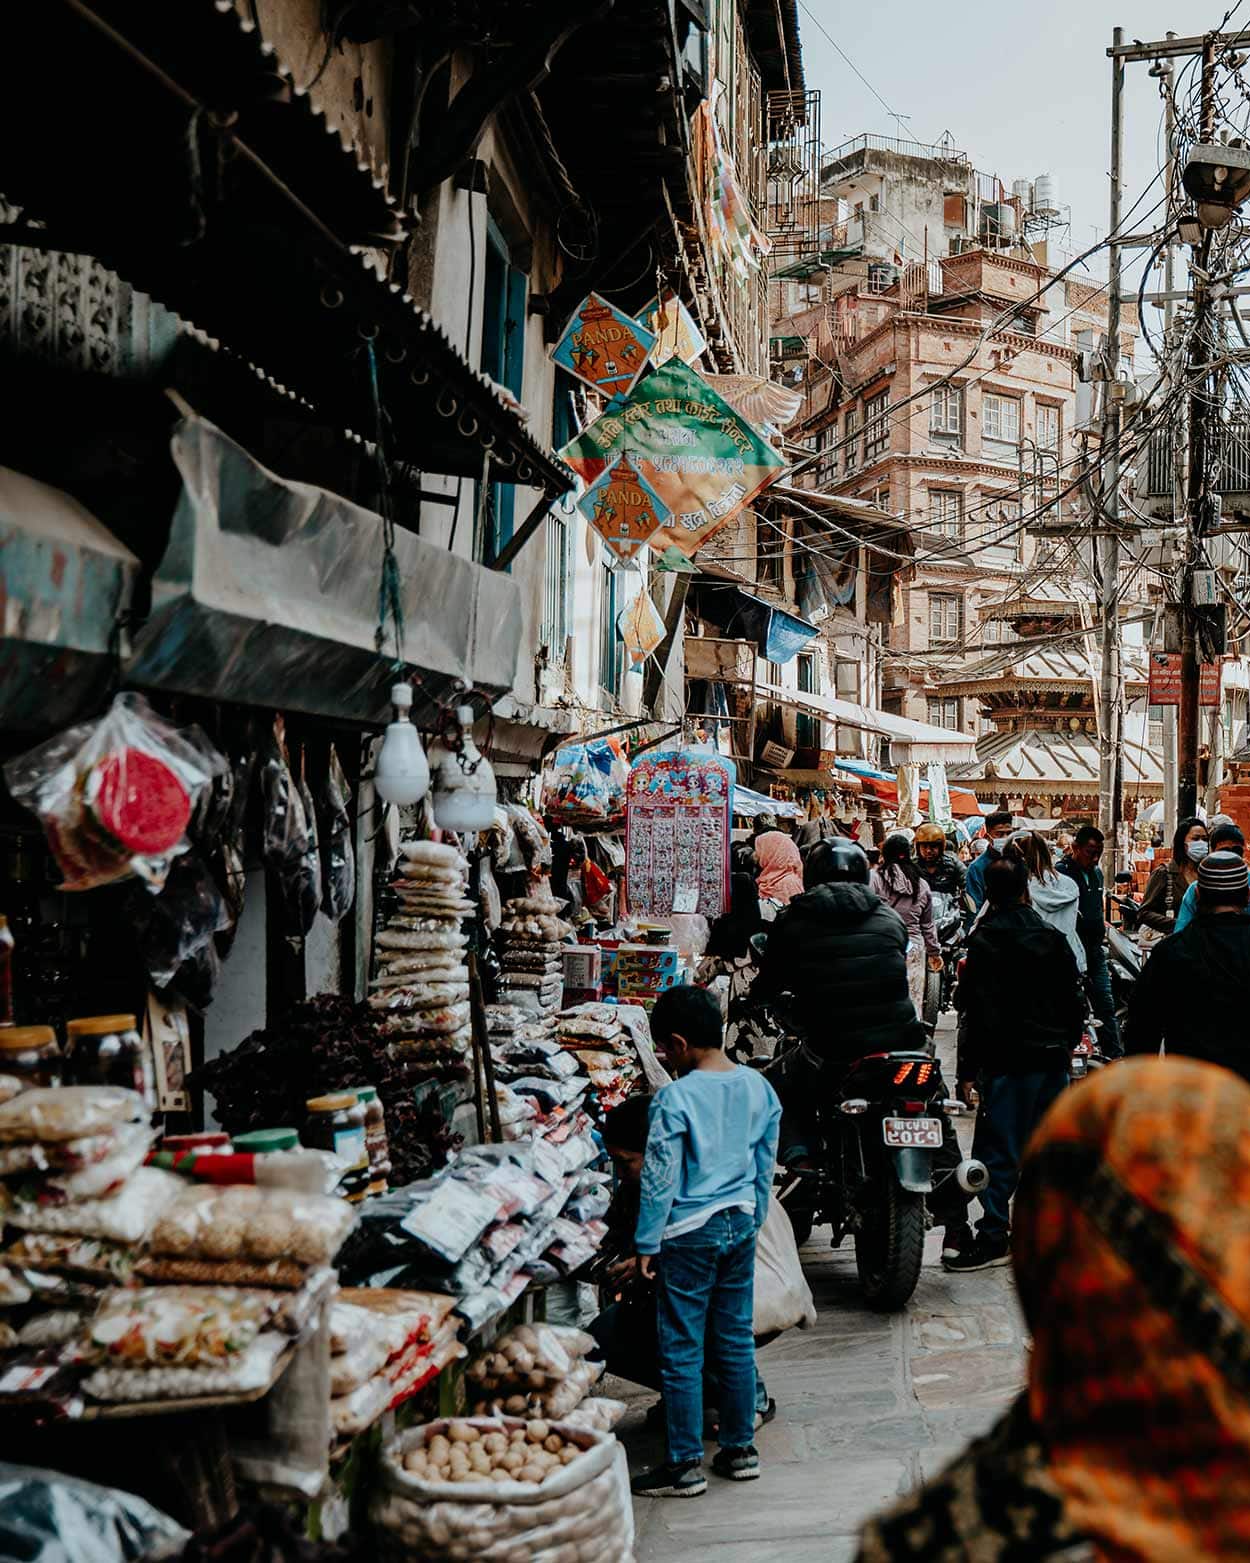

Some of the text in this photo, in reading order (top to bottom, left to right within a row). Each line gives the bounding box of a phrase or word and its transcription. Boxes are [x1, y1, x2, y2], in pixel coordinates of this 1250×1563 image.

[572, 327, 634, 347] PANDA
[655, 399, 681, 414] तथा
[598, 488, 652, 507] PANDA
